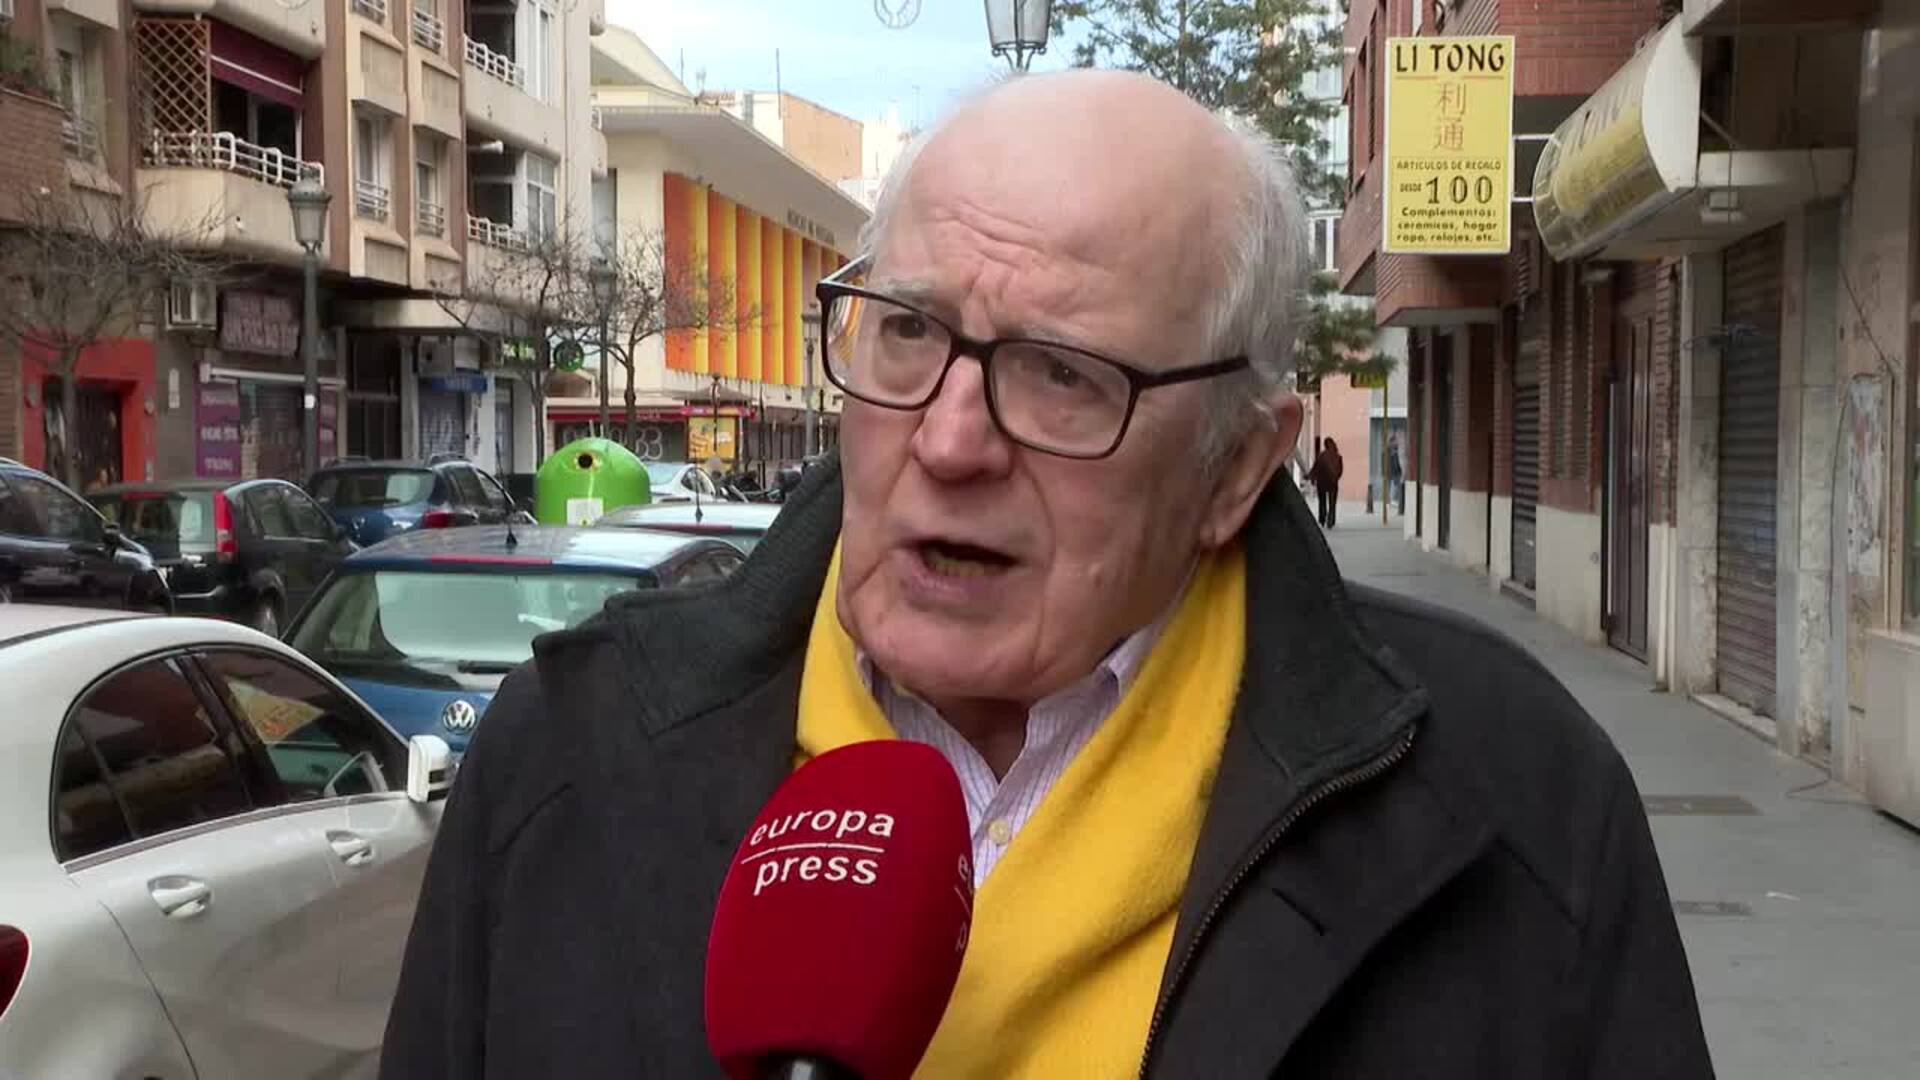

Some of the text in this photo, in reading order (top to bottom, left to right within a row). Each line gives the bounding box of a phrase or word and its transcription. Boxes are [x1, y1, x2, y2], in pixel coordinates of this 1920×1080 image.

[1396, 43, 1504, 72] LI TONG
[1451, 160, 1462, 170] DE
[1465, 160, 1501, 170] REGALO
[1425, 175, 1493, 204] 100
[1463, 221, 1497, 231] hogar
[750, 809, 895, 845] europa
[754, 855, 879, 896] press
